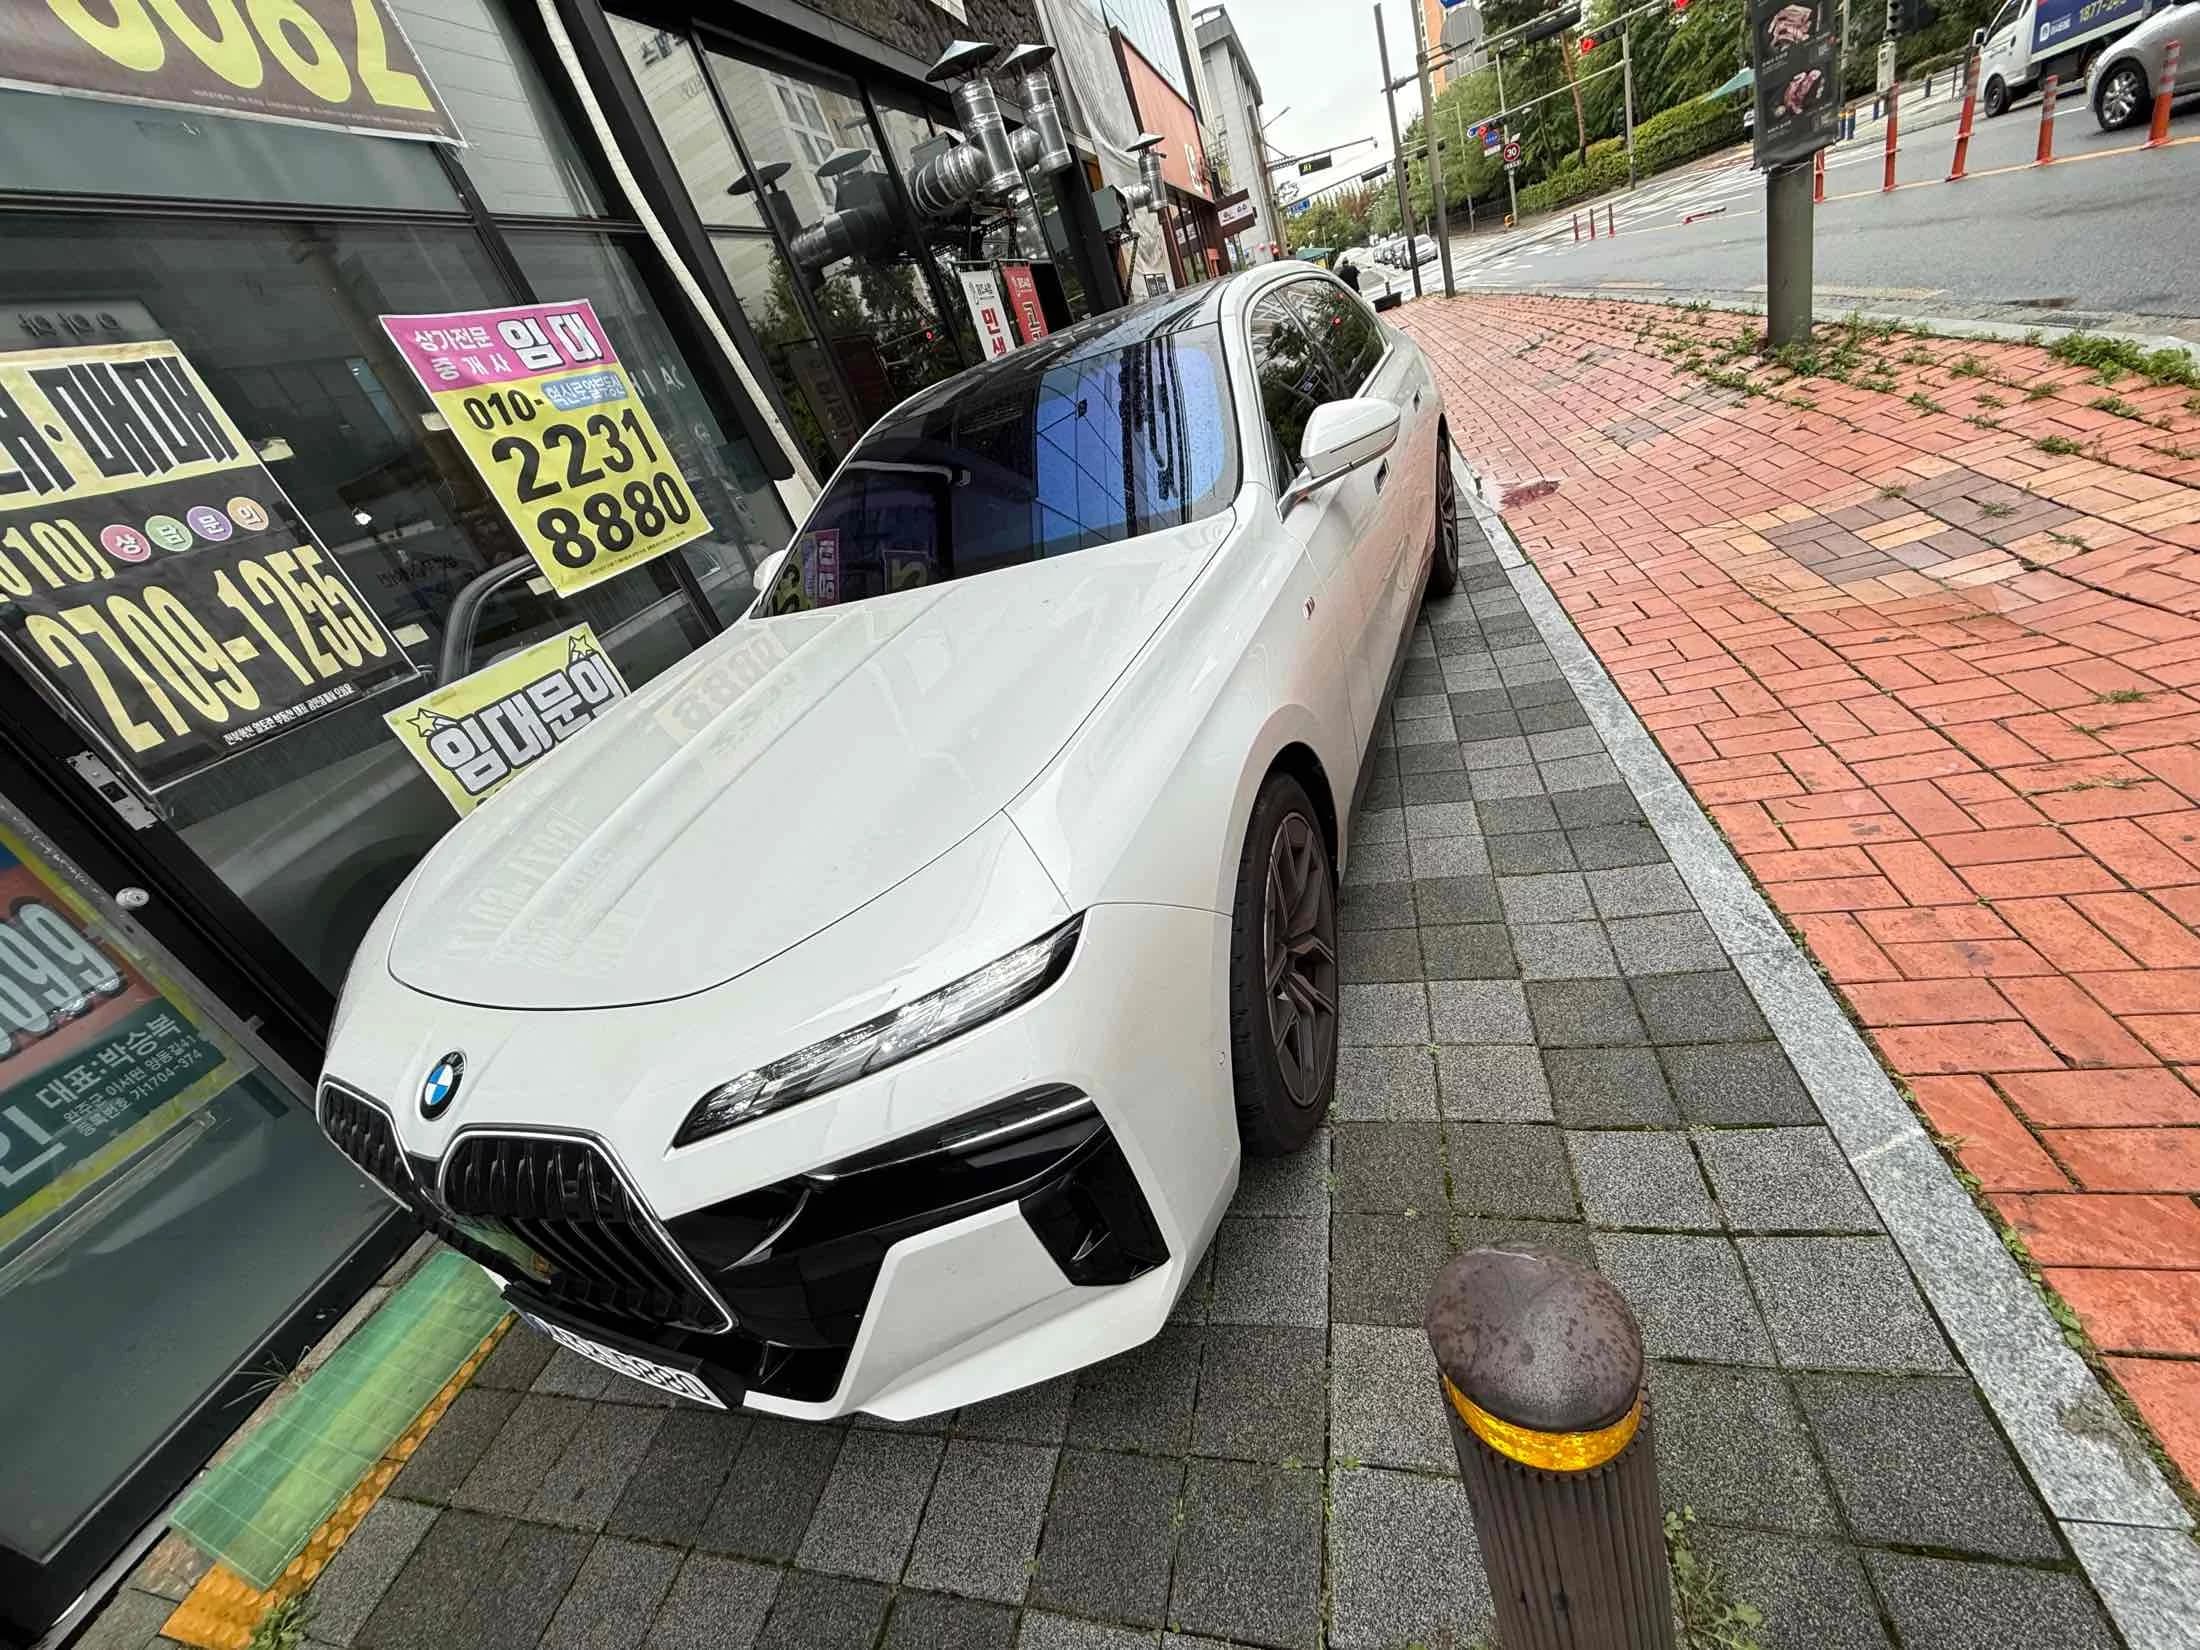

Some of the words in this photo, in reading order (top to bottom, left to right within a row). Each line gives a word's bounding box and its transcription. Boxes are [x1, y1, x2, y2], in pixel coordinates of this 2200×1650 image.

[1507, 147, 1517, 158] 30
[415, 326, 495, 352] 상가전문
[496, 312, 604, 371] 임대
[491, 408, 657, 504] 2231
[537, 471, 691, 568] 8880
[25, 544, 387, 753] 2709-1255
[427, 652, 628, 796] 임대문의
[611, 1352, 711, 1400] 5880
